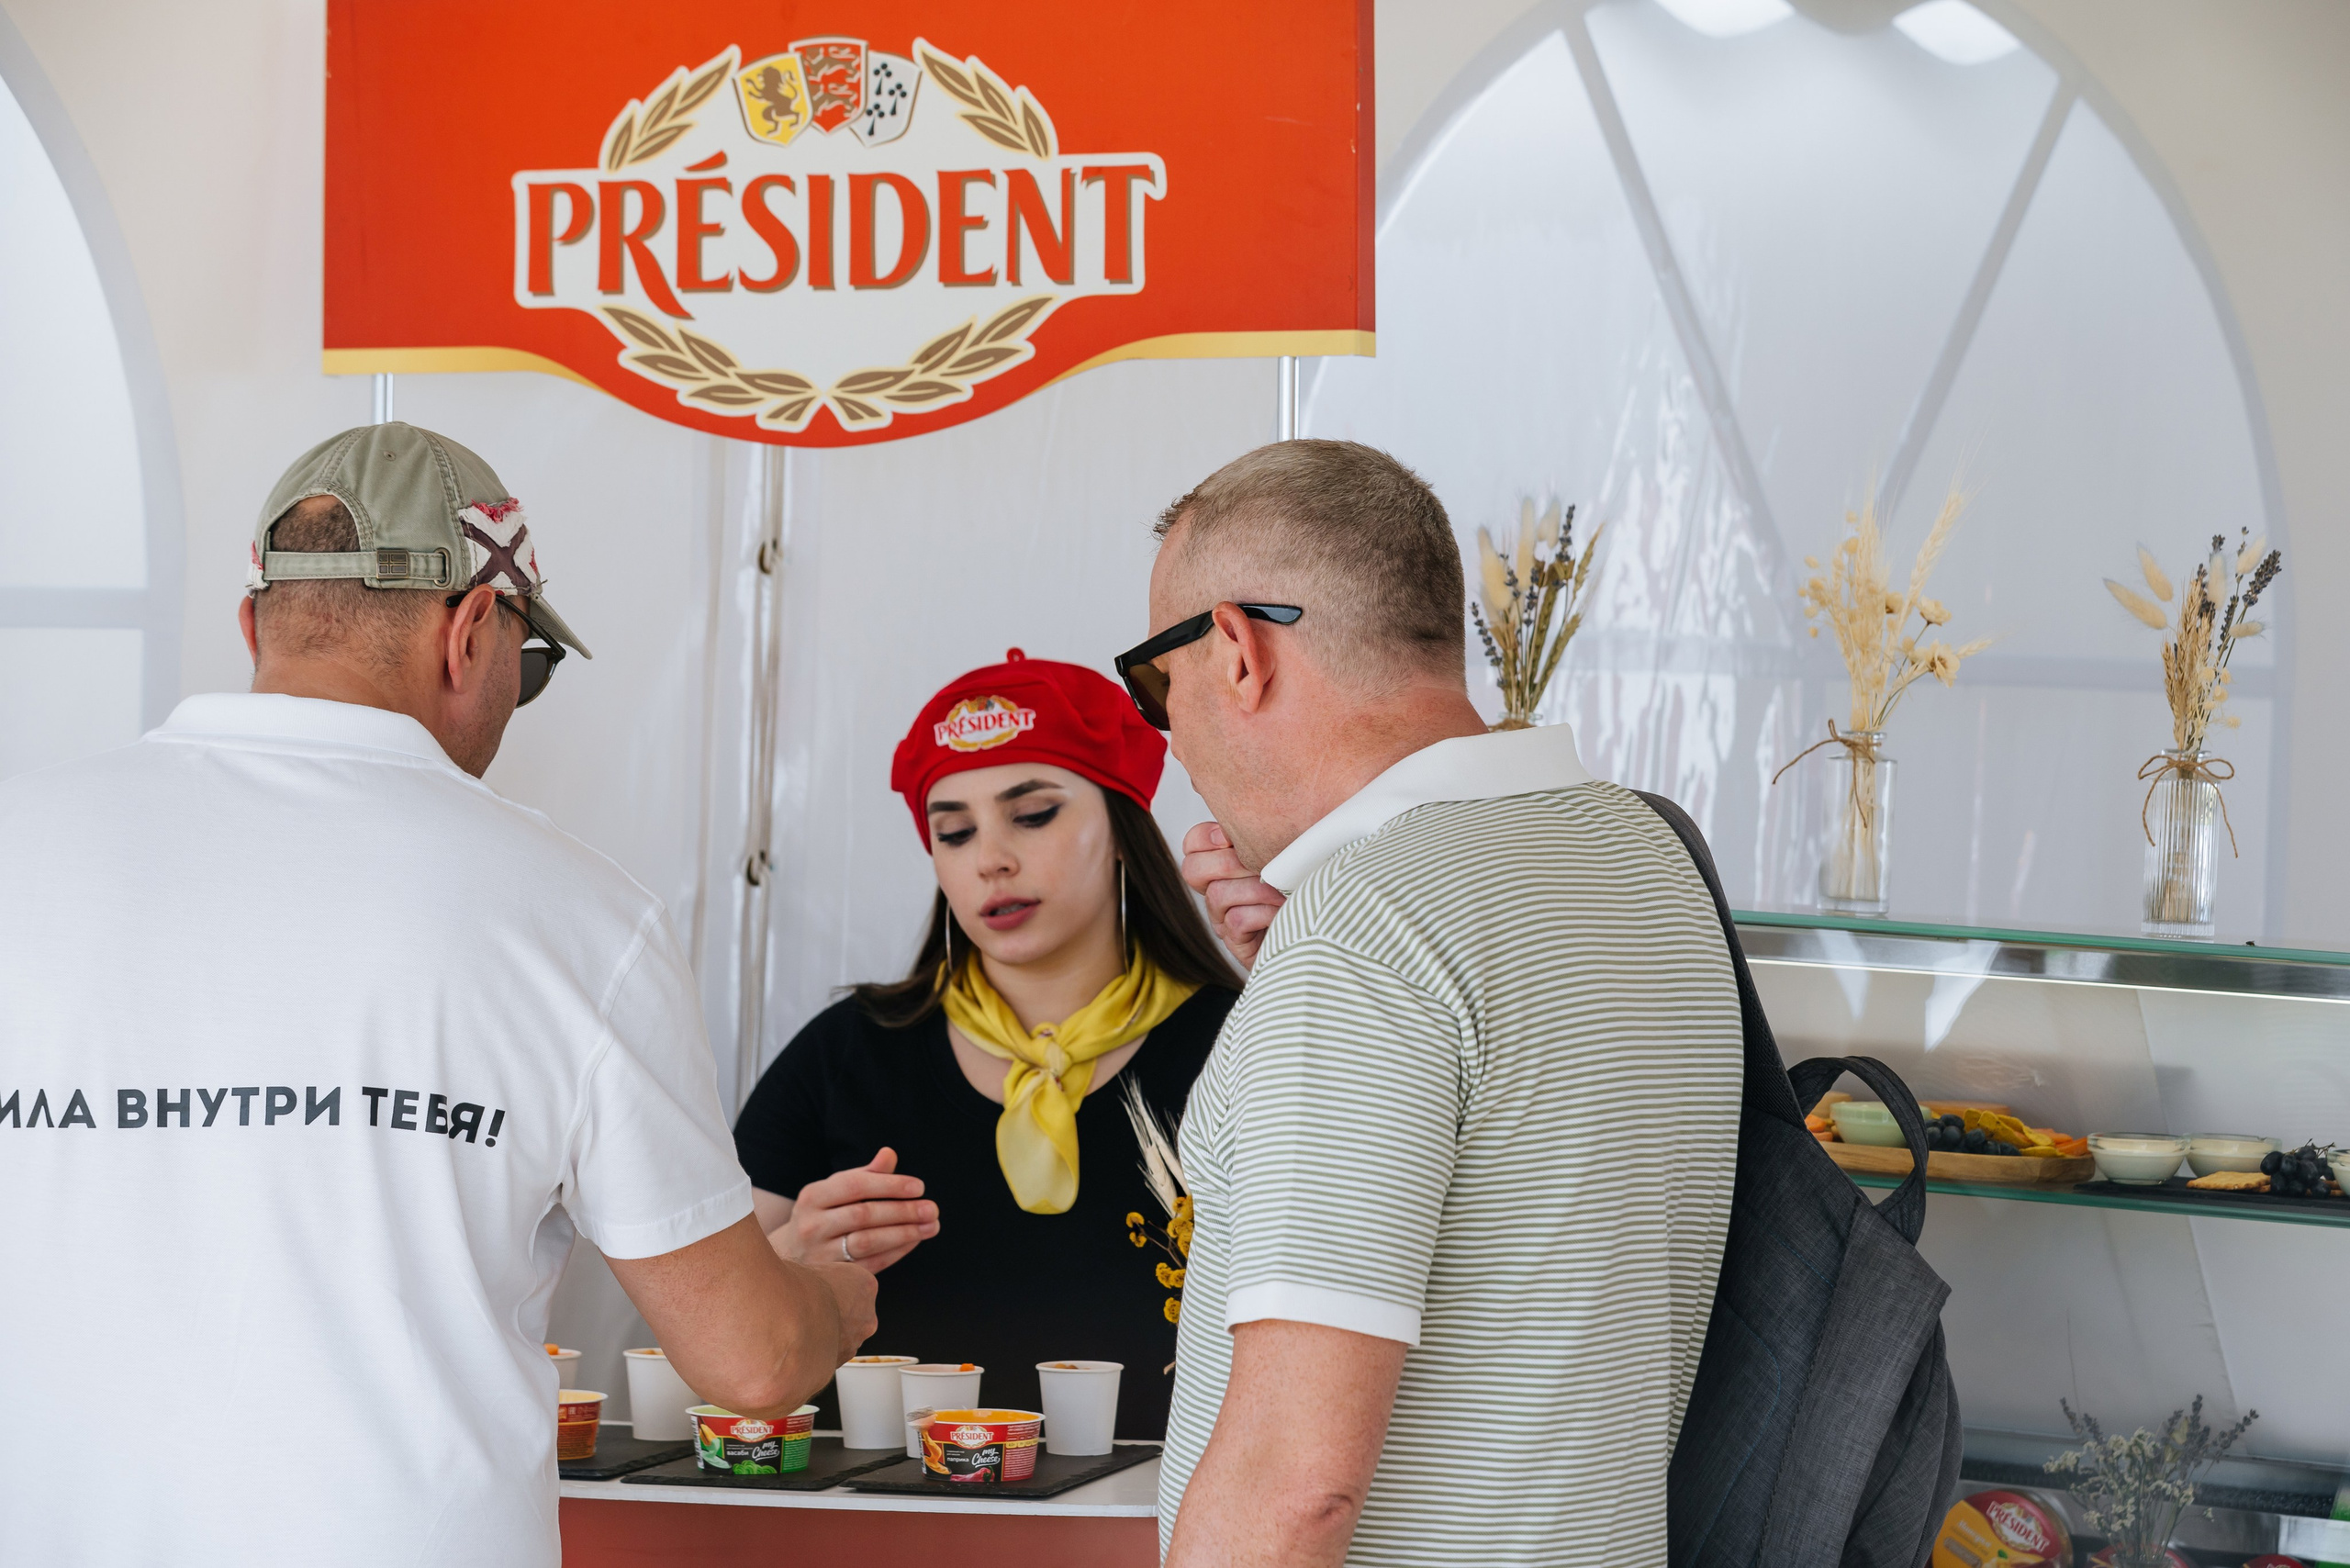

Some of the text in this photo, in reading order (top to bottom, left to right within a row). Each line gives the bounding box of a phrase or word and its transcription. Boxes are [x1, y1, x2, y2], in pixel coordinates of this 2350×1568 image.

[527, 149, 1154, 320] PRÉSIDENT
[937, 711, 1034, 740] PRÉSIDENT
[118, 1086, 341, 1129] ВНУТРИ
[362, 1086, 505, 1148] ТЕБЯ!
[731, 1425, 773, 1435] PRÉSIDENT
[951, 1431, 993, 1441] PRÉSIDENT
[752, 1446, 779, 1461] Cheese
[981, 1447, 999, 1456] my
[971, 1452, 1001, 1467] Cheese
